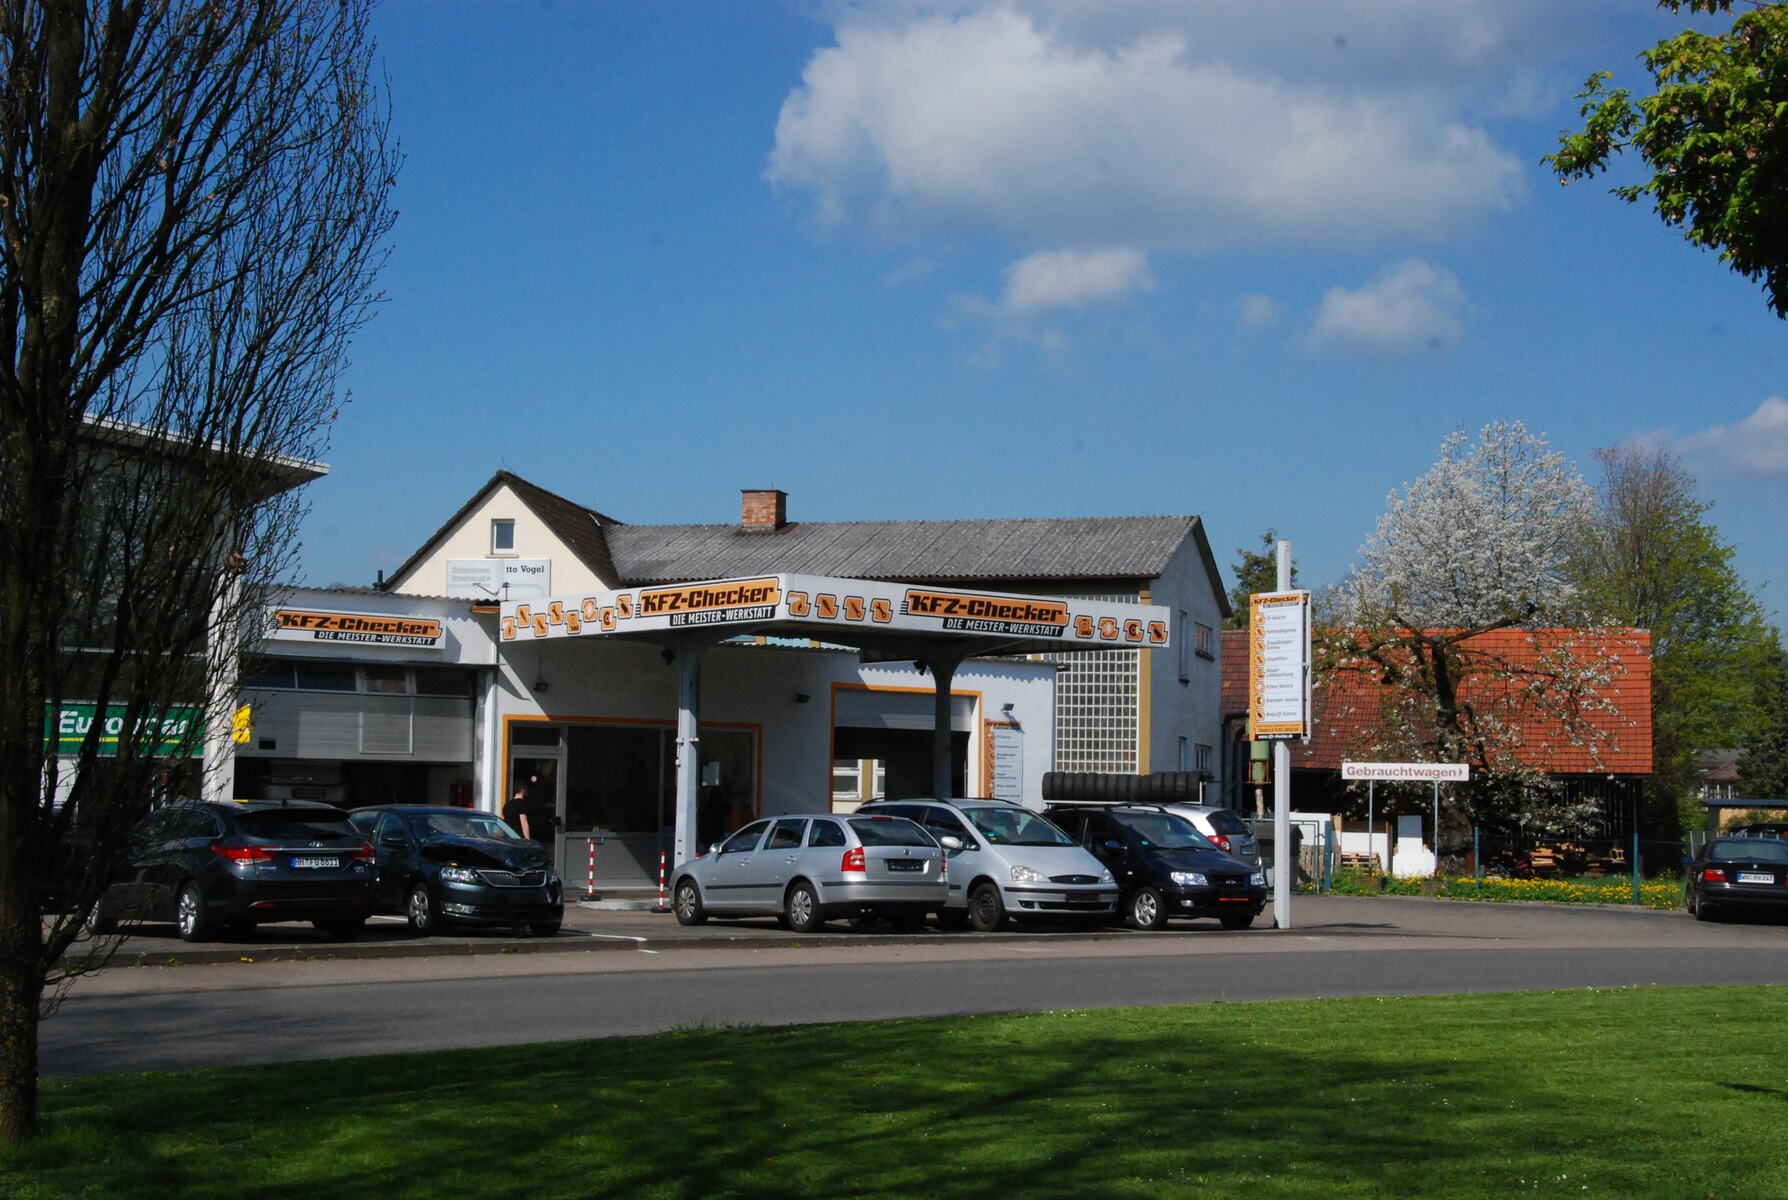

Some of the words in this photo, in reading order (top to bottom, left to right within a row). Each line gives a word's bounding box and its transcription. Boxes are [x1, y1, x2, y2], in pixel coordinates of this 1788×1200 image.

[505, 566, 518, 574] tto
[521, 565, 545, 575] Vogel
[641, 586, 774, 612] KFZ-Checker
[909, 594, 1063, 622] KFZ-Checker
[279, 613, 435, 635] KFZ-Checker
[672, 615, 686, 626] DIE
[688, 606, 773, 624] MEISTER-WERKSTATT
[946, 618, 961, 629] DIE
[965, 619, 1061, 636] MEISTER-WERKSTATT
[318, 631, 335, 640] DIE
[337, 632, 433, 646] MEISTER-WERKSTATT
[1346, 766, 1457, 779] Gebrauchtwagen
